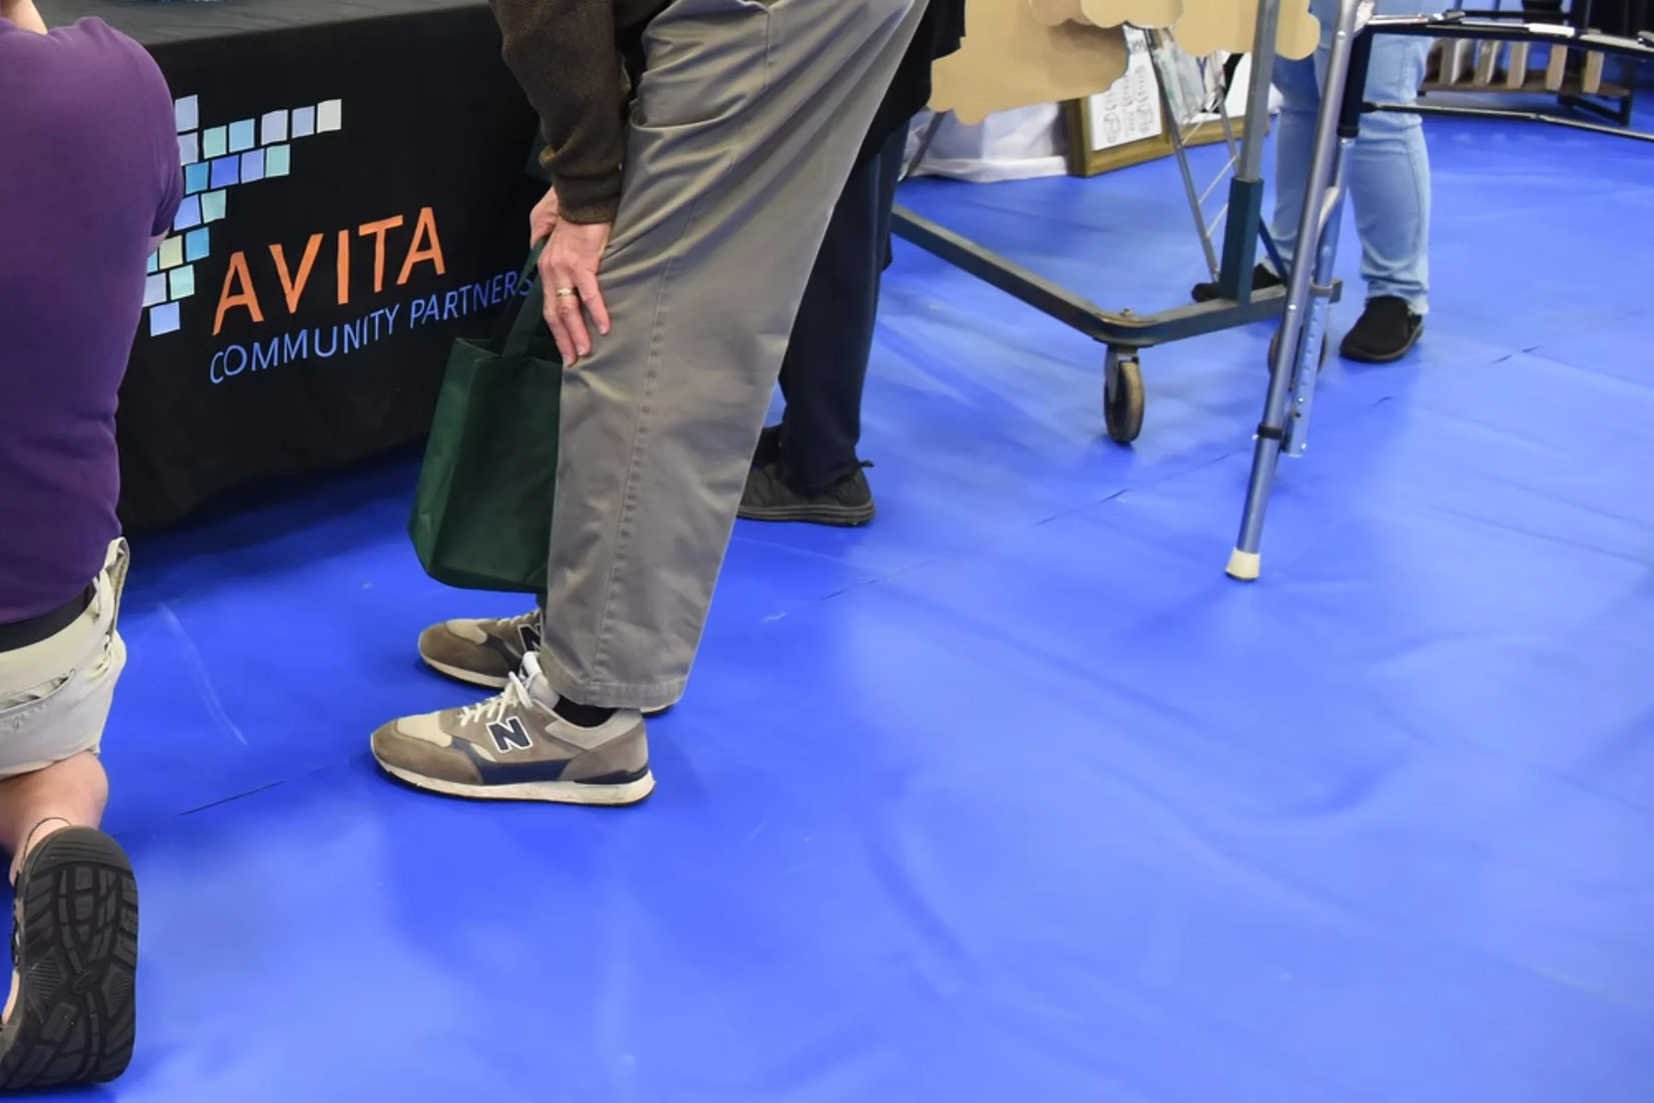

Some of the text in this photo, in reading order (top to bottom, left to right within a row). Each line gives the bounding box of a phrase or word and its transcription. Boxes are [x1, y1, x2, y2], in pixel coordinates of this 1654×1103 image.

[212, 206, 447, 337] AVITA
[209, 303, 401, 384] COMMUNITY
[486, 716, 534, 753] N
